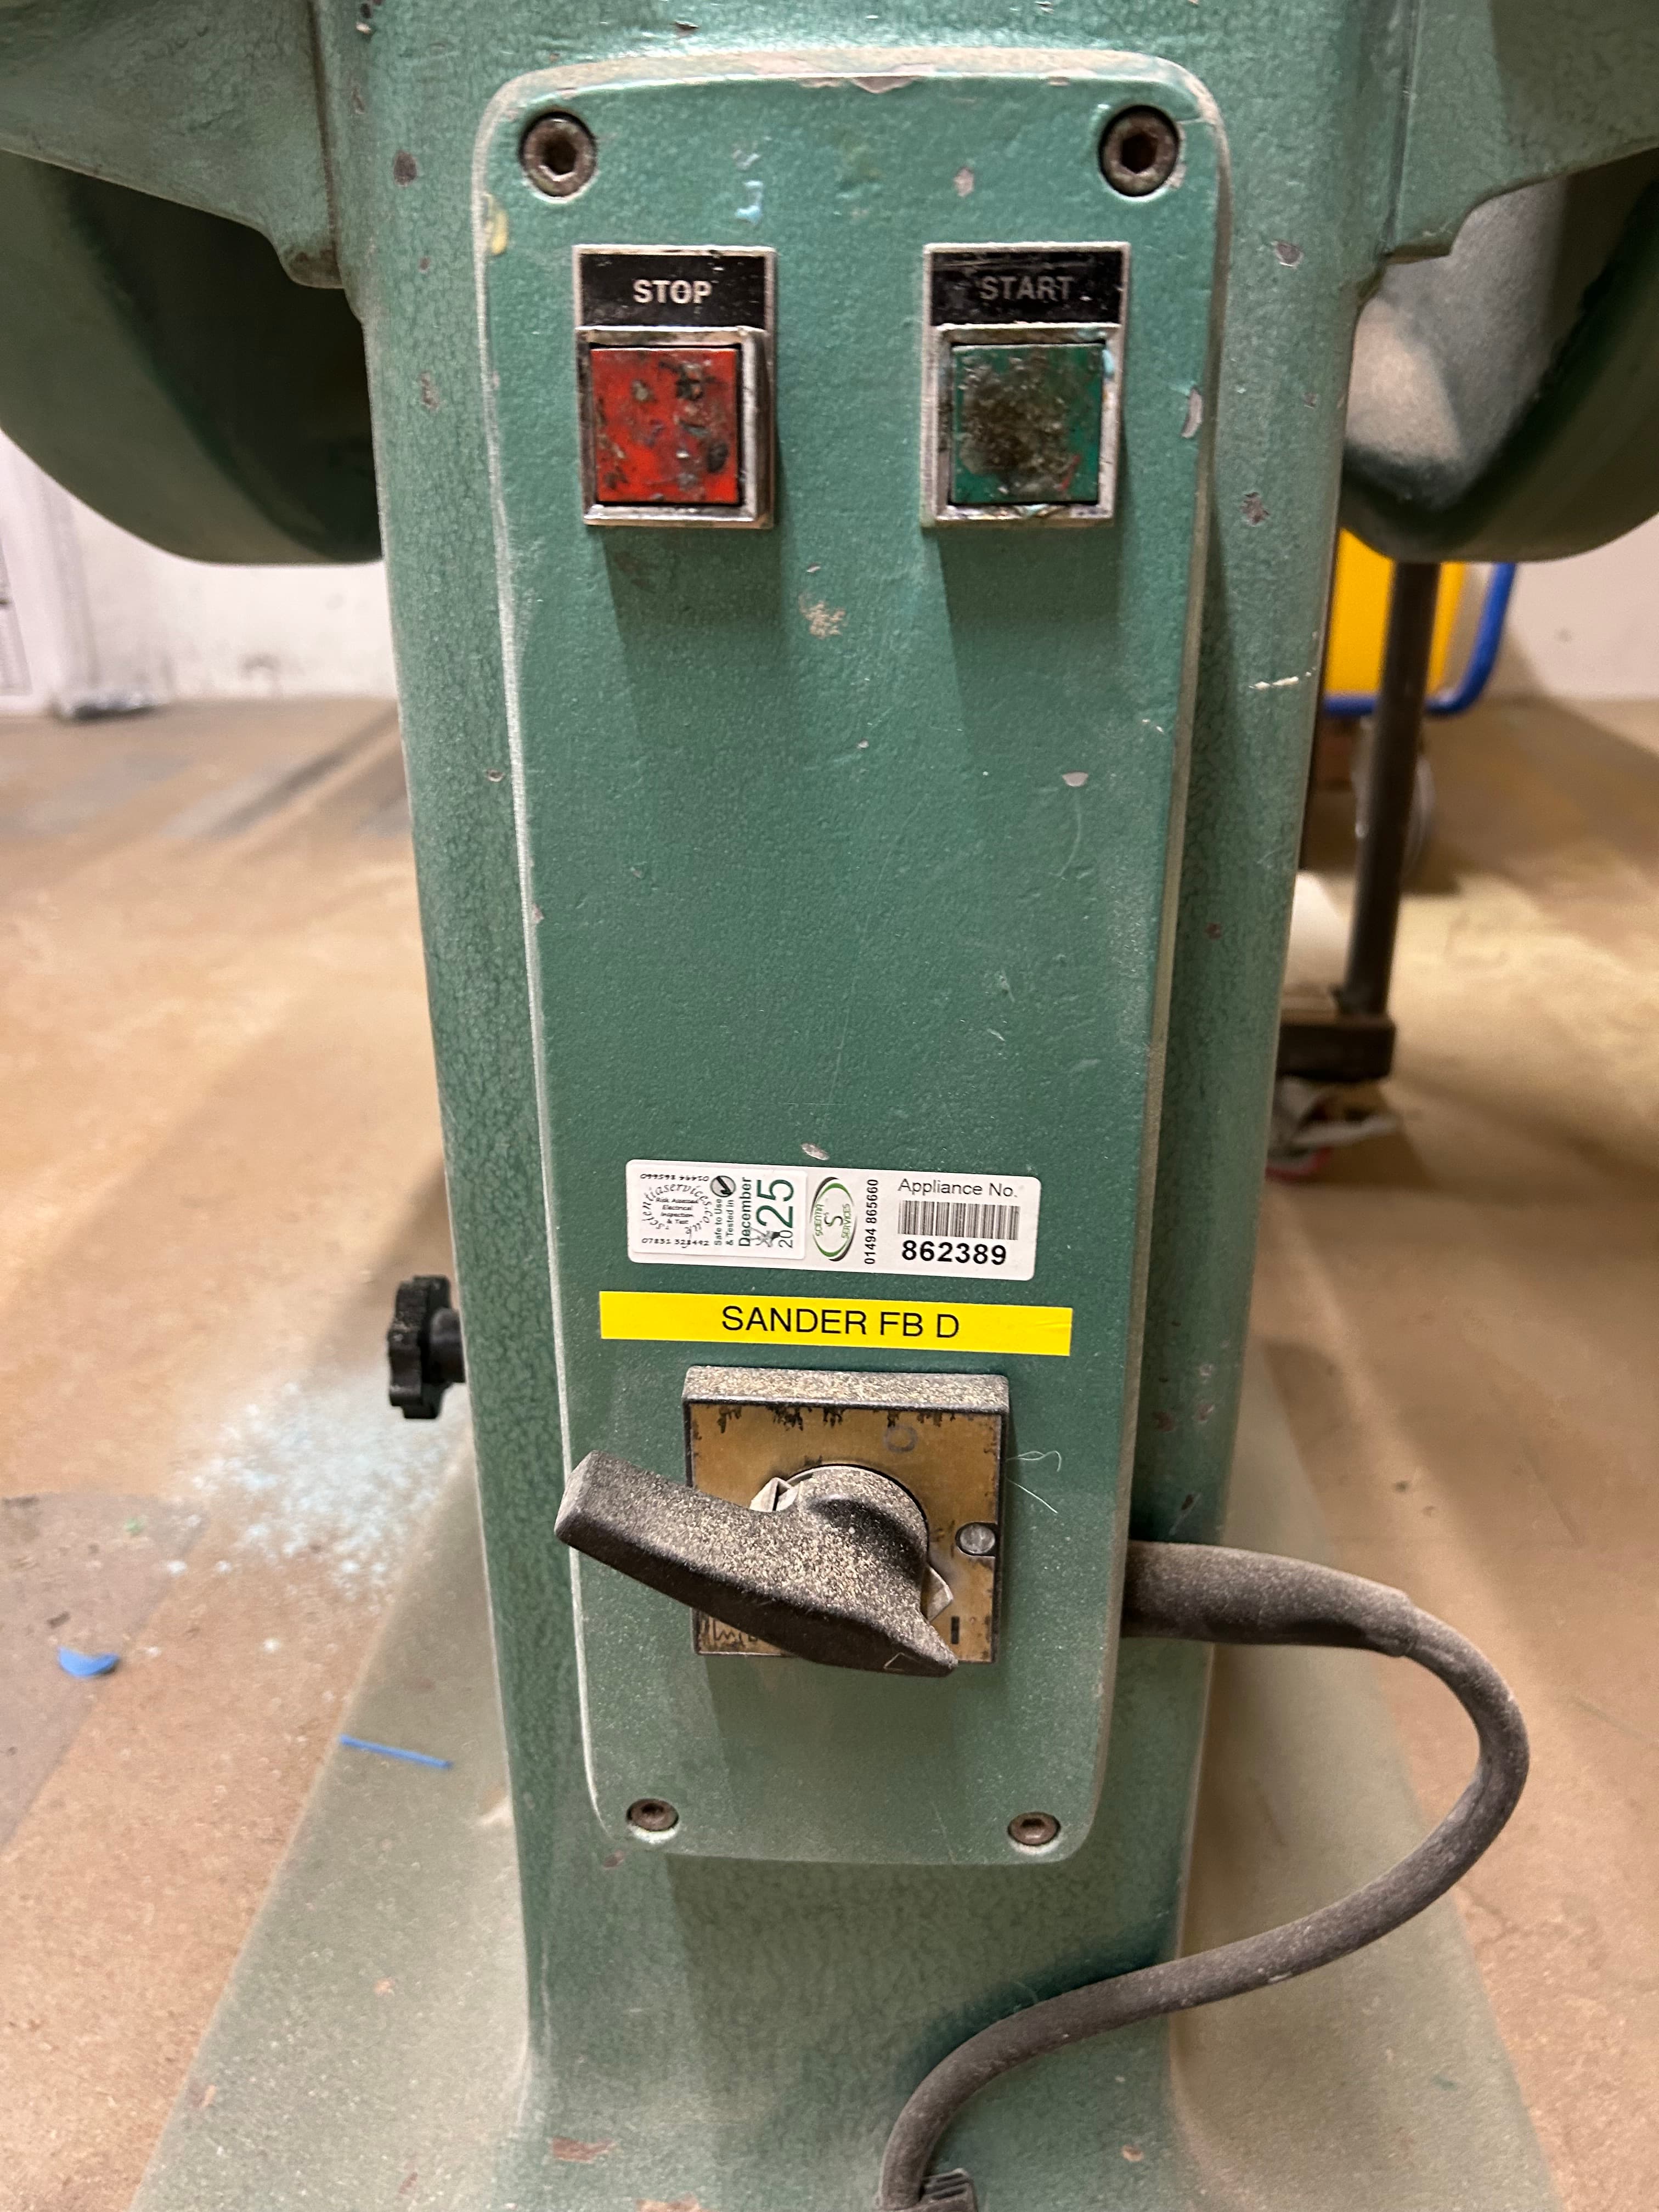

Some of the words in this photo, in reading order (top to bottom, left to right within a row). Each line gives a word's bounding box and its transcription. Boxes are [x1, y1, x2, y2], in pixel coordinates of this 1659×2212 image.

[633, 279, 712, 303] STOP
[979, 276, 1074, 301] START
[898, 1178, 983, 1196] Appliance
[989, 1182, 1018, 1198] No.
[714, 1199, 723, 1214] Use
[738, 1177, 752, 1246] December
[865, 1179, 879, 1223] 865660
[715, 1216, 723, 1225] to
[726, 1210, 734, 1237] Tested
[714, 1228, 723, 1245] Safe
[864, 1228, 877, 1265] 01494
[902, 1240, 1007, 1265] 862389
[722, 1306, 867, 1335] SANDER
[880, 1312, 923, 1336] FB
[936, 1314, 960, 1338] D
